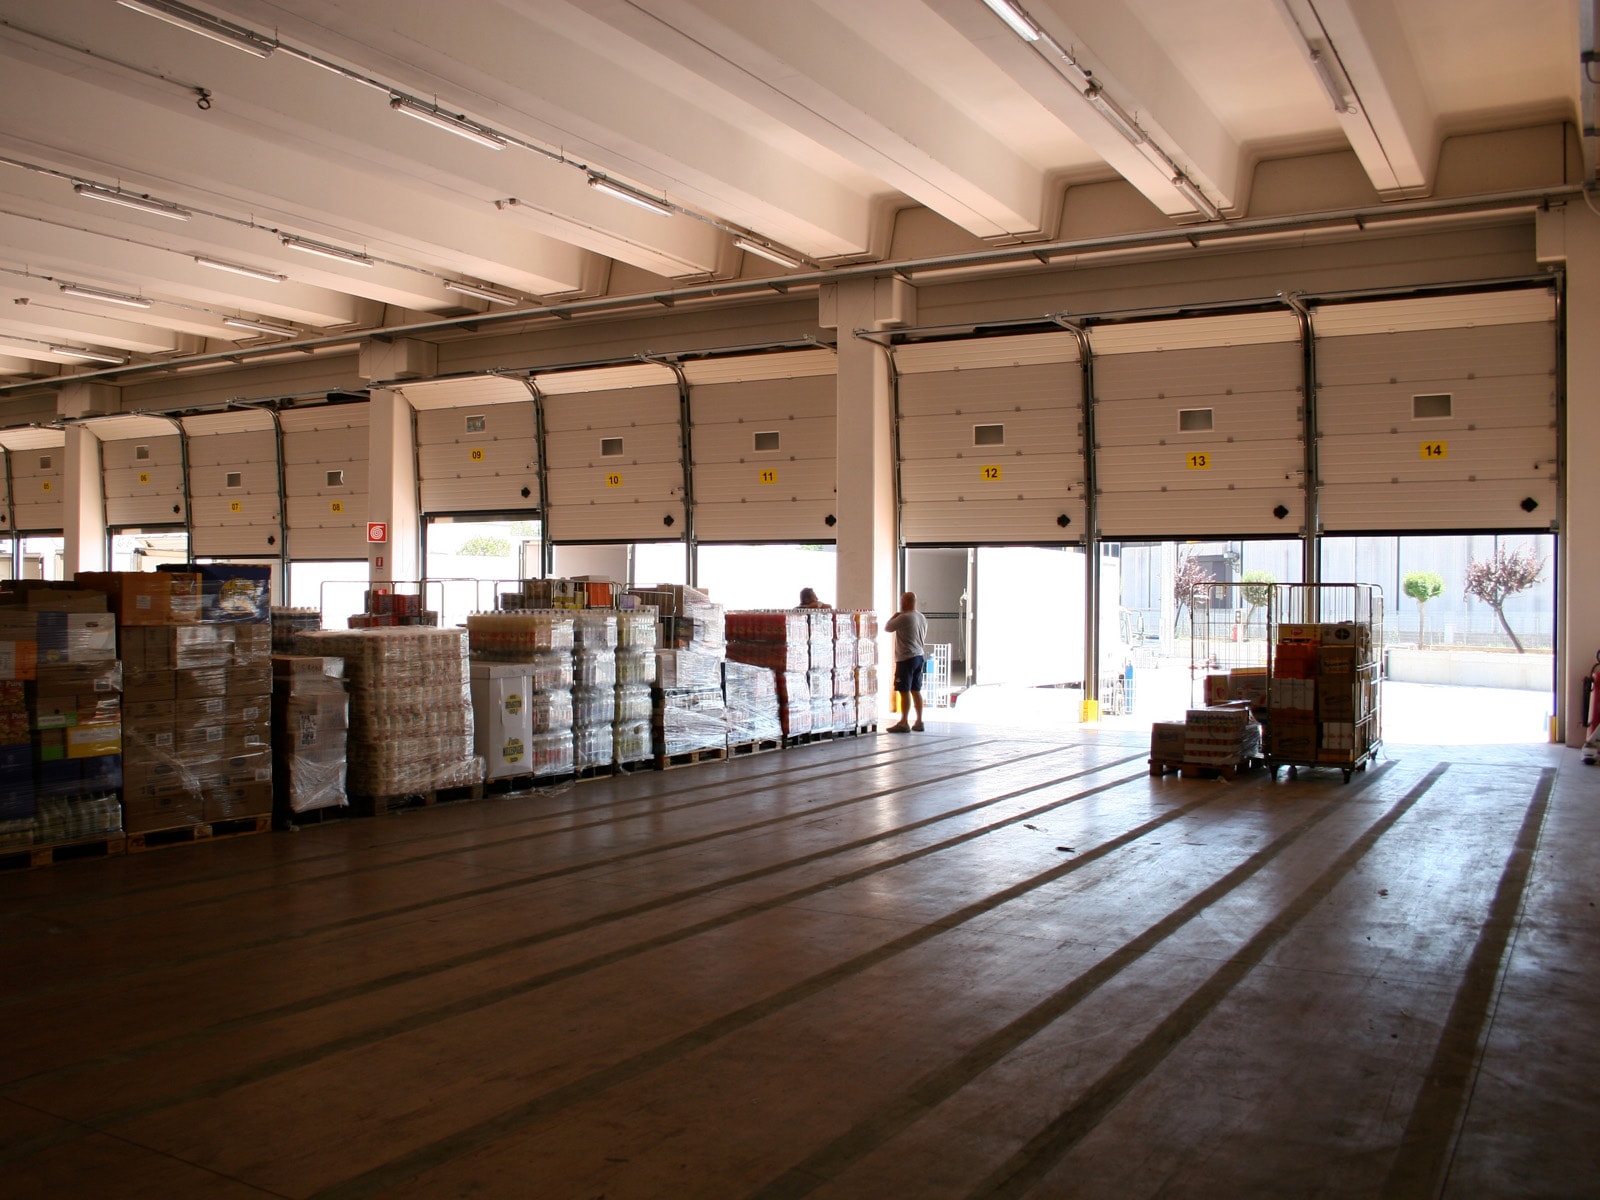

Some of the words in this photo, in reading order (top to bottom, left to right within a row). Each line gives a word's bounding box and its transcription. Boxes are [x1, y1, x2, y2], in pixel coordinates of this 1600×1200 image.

[472, 450, 481, 459] 09
[1425, 445, 1442, 457] 14
[1191, 456, 1206, 466] 13
[763, 472, 773, 481] 11
[985, 468, 998, 478] 12
[609, 476, 619, 485] 10
[231, 503, 239, 511] 07
[332, 503, 341, 512] 08
